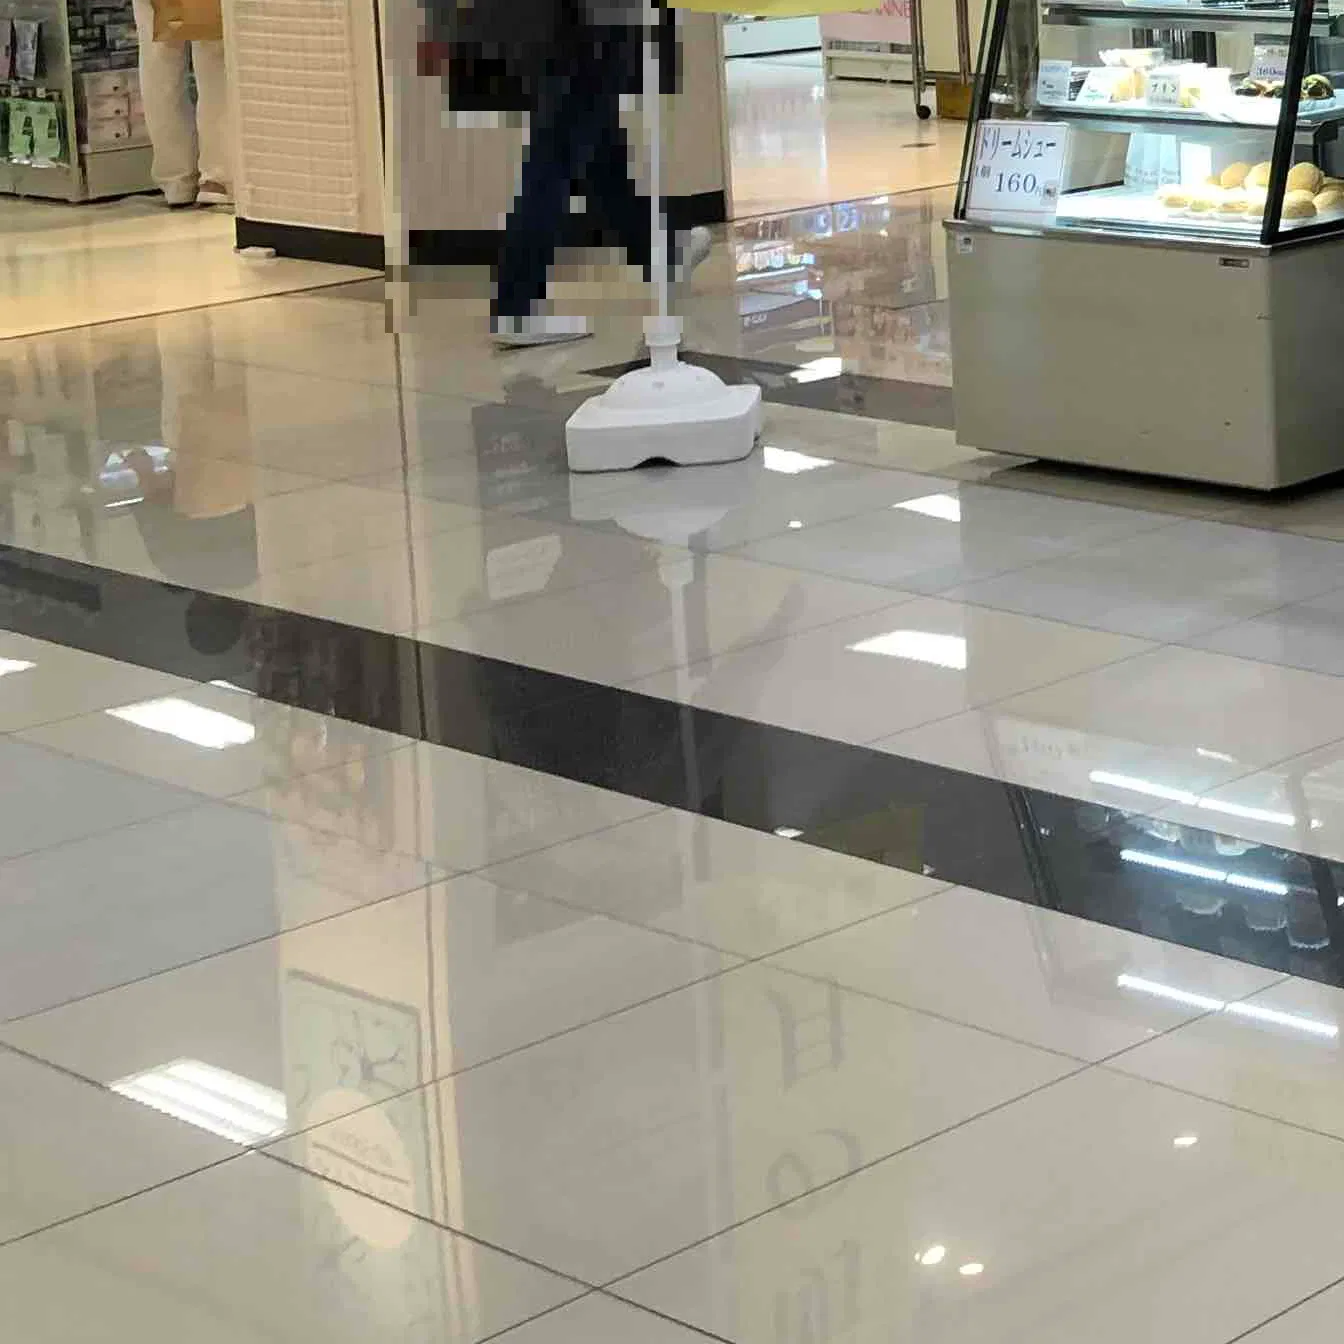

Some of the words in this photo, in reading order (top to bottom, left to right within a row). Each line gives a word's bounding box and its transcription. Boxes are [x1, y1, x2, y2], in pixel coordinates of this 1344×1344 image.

[979, 127, 1057, 161] ドリームシュー
